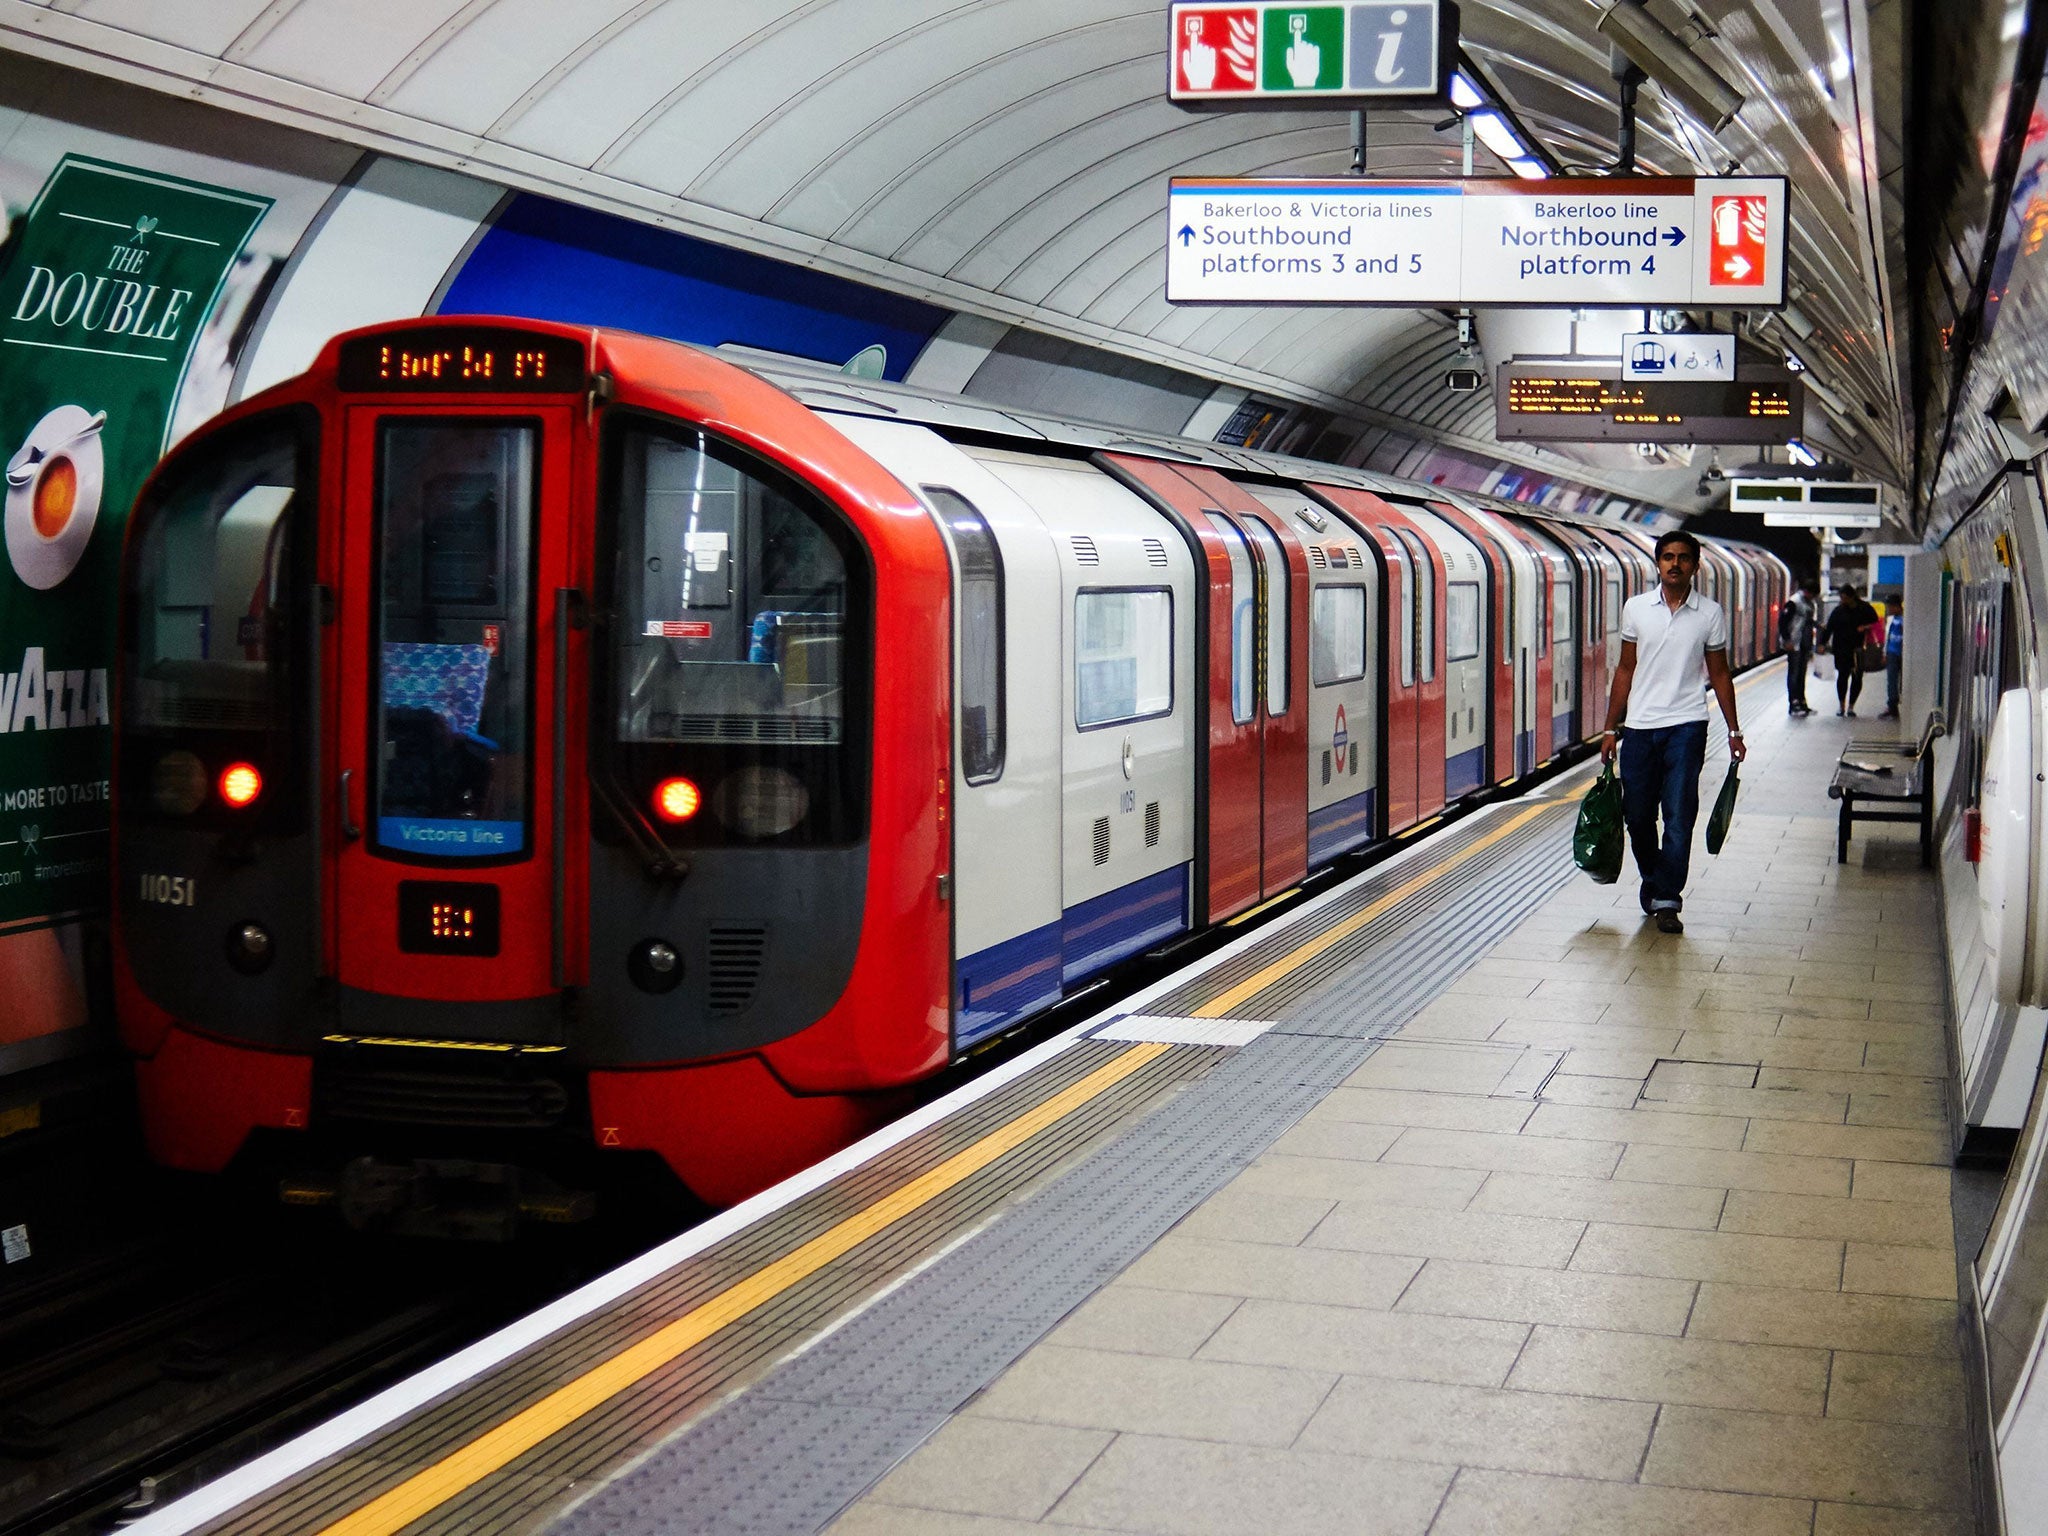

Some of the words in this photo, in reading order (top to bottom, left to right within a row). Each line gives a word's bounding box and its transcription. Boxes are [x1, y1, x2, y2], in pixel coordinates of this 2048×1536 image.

[1203, 202, 1282, 218] Bakerloo
[1289, 203, 1302, 218] &
[1310, 202, 1382, 218] Victoria
[1389, 202, 1433, 218] lines
[1534, 202, 1616, 219] Bakerloo
[1624, 202, 1659, 219] line
[1202, 225, 1352, 246] Southbound
[1501, 226, 1658, 247] Northbound
[107, 244, 150, 275] THE
[1202, 253, 1322, 278] platforms
[1332, 254, 1346, 274] 3
[1354, 253, 1398, 274] and
[1408, 254, 1422, 274] 5
[1520, 254, 1632, 280] platform
[1640, 255, 1657, 276] 4
[10, 265, 194, 341] DOUBLE
[4, 787, 46, 812] MORE
[48, 785, 68, 806] TO
[70, 780, 110, 804] TASTE
[400, 824, 467, 844] Victoria
[472, 826, 505, 844] line
[140, 872, 196, 908] 11051
